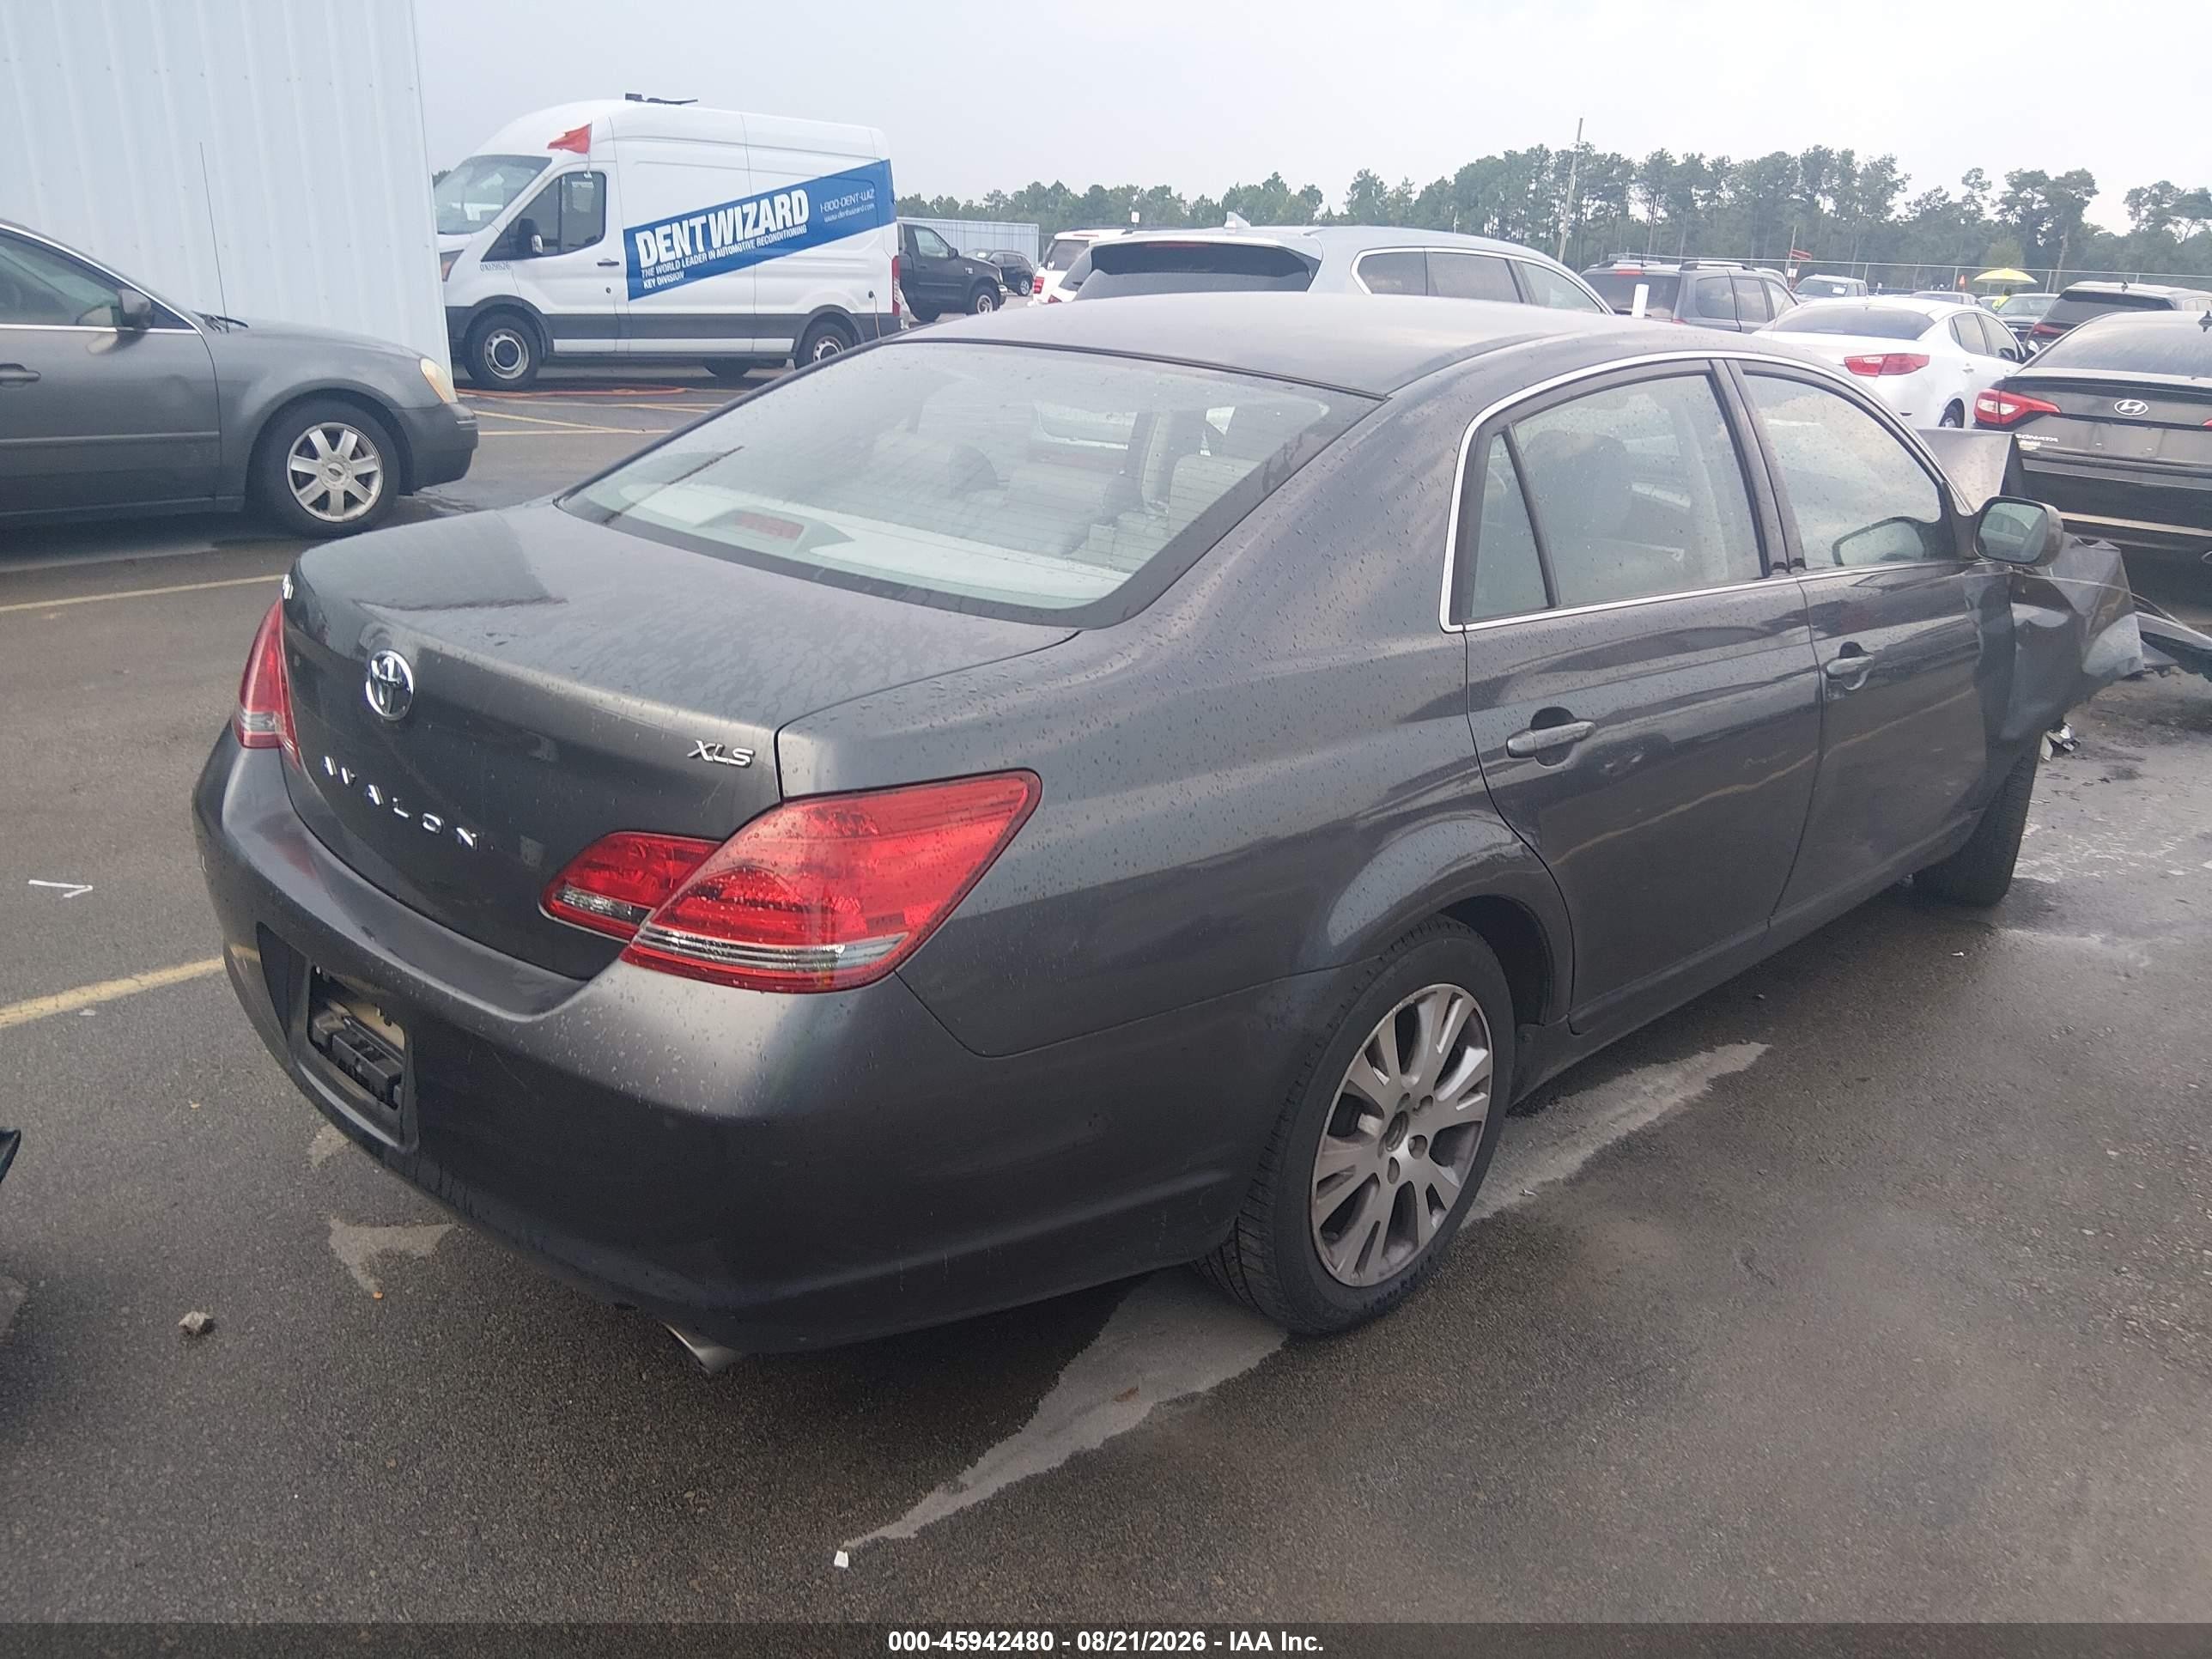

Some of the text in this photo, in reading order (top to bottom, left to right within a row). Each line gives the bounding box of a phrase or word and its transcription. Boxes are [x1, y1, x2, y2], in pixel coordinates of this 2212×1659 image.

[635, 189, 810, 269] DENT WIZARD
[641, 223, 807, 279] THE WORLD LEADER IN AUTOMOTIVE RECONDITIONING
[643, 270, 684, 289] KEY DIVISION
[687, 739, 756, 767] XLS
